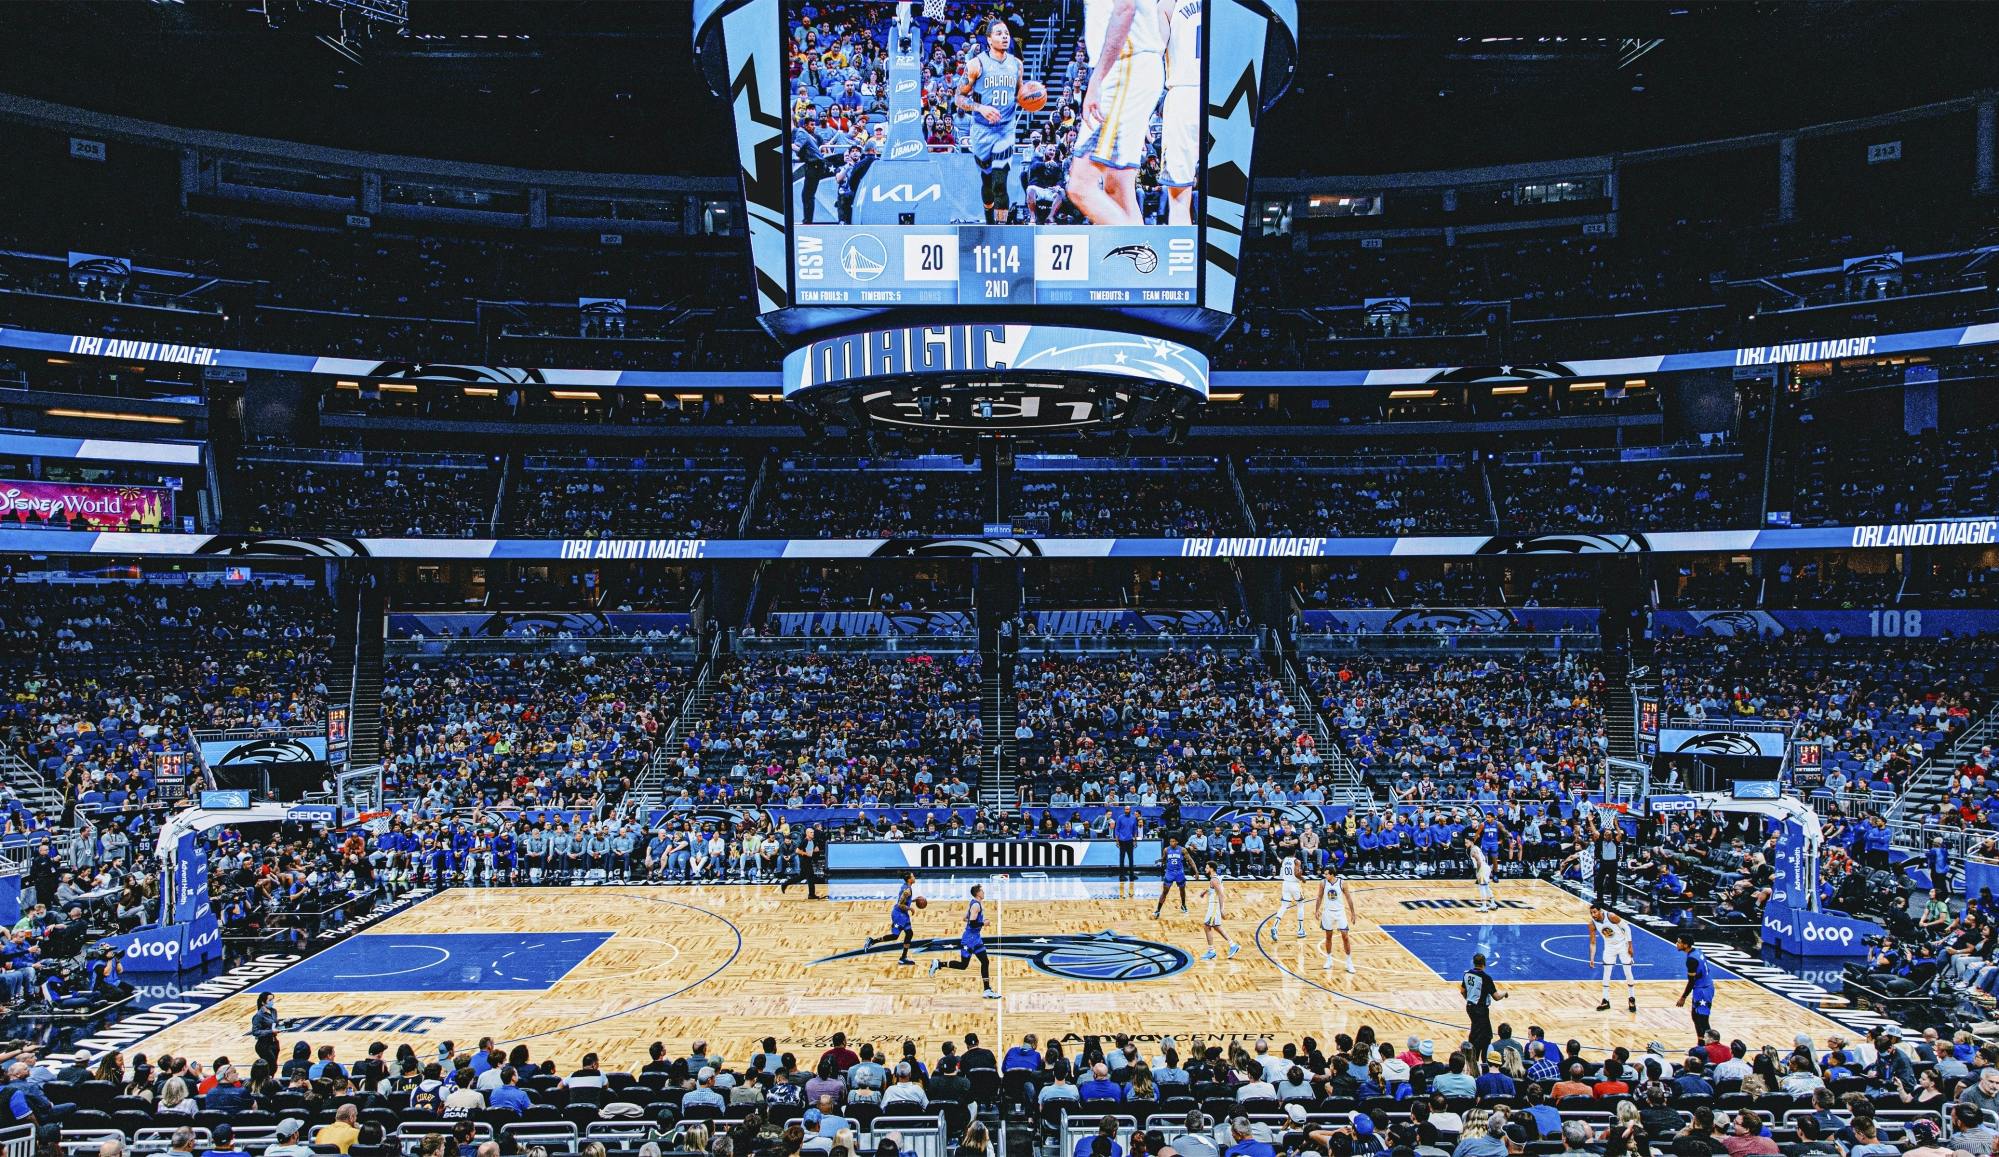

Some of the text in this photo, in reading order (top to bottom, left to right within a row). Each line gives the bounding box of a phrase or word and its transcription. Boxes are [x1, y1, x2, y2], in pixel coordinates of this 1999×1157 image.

[992, 91, 1008, 106] 20
[891, 143, 921, 160] LIBMAN
[798, 236, 824, 280] GSW
[921, 244, 943, 270] 20
[973, 245, 1020, 273] 11:14
[1051, 244, 1073, 271] 27
[1168, 238, 1195, 276] ORL
[801, 291, 819, 301] TEAM
[820, 291, 843, 301] FOULS:
[861, 290, 896, 301] TIMEOUTS:
[985, 280, 1009, 298] 2ND
[1090, 291, 1124, 301] TIMEOUTS:
[1142, 291, 1161, 301] TEAM
[1162, 291, 1184, 301] FOULS:
[69, 335, 221, 366] ORLANDO MAGIC
[811, 324, 1006, 387] MAGIC
[1735, 336, 1876, 366] ORLANDO MAGIC
[63, 495, 122, 514] World
[1851, 521, 1997, 548] ORLANDO MAGIC
[560, 540, 706, 559] ORLANDO MAGIC
[1181, 538, 1327, 556] ORLANDO MAGIC
[1868, 610, 1922, 637] 108
[1801, 754, 1816, 764] 21
[163, 765, 178, 775] 21
[1652, 801, 1695, 811] GEICO
[287, 811, 332, 820] GEICO
[139, 842, 150, 851] 99
[920, 842, 1075, 867] ORLANDO
[1284, 866, 1293, 876] 00
[181, 859, 189, 905] AdventHealth
[1803, 921, 1854, 947] drop
[126, 938, 180, 961] drop
[179, 953, 301, 999] MAGIC
[1467, 976, 1476, 987] 25
[1173, 1033, 1275, 1042] CENTER
[416, 1093, 436, 1102] CURRY
